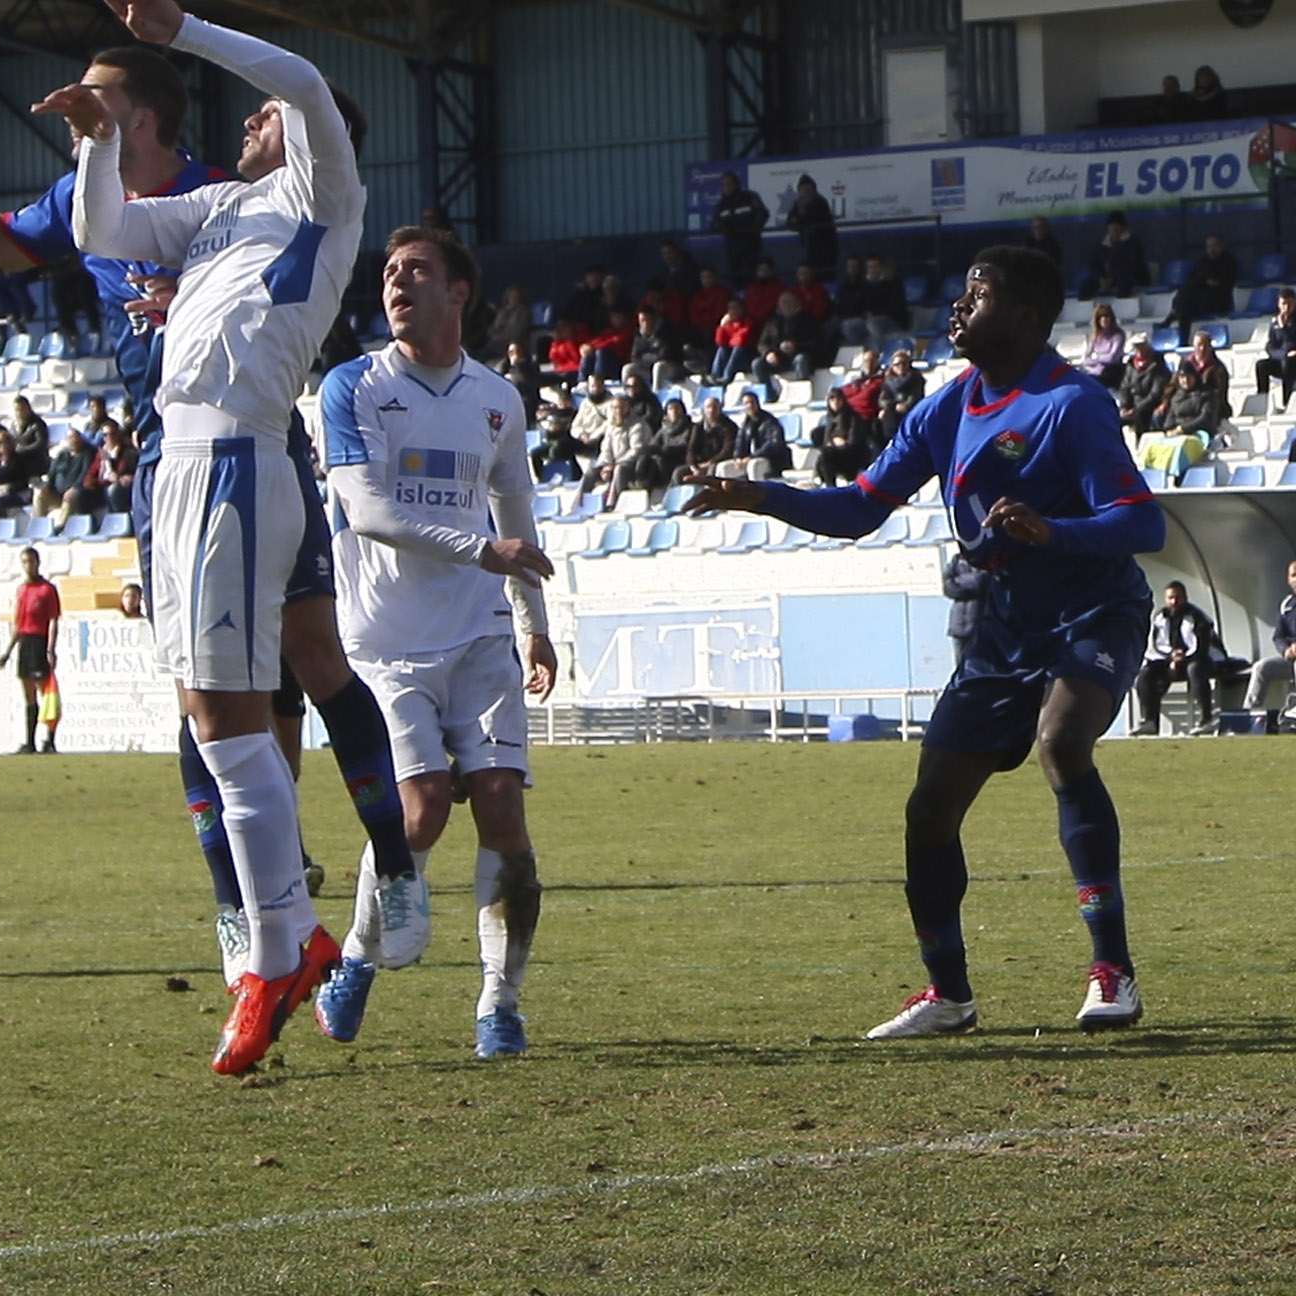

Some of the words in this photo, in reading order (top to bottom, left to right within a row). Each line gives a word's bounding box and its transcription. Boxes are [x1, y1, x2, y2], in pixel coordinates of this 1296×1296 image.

[1025, 165, 1078, 185] Estadio
[1084, 161, 1124, 199] EL
[1135, 153, 1242, 195] SOTO
[395, 481, 474, 509] islazul
